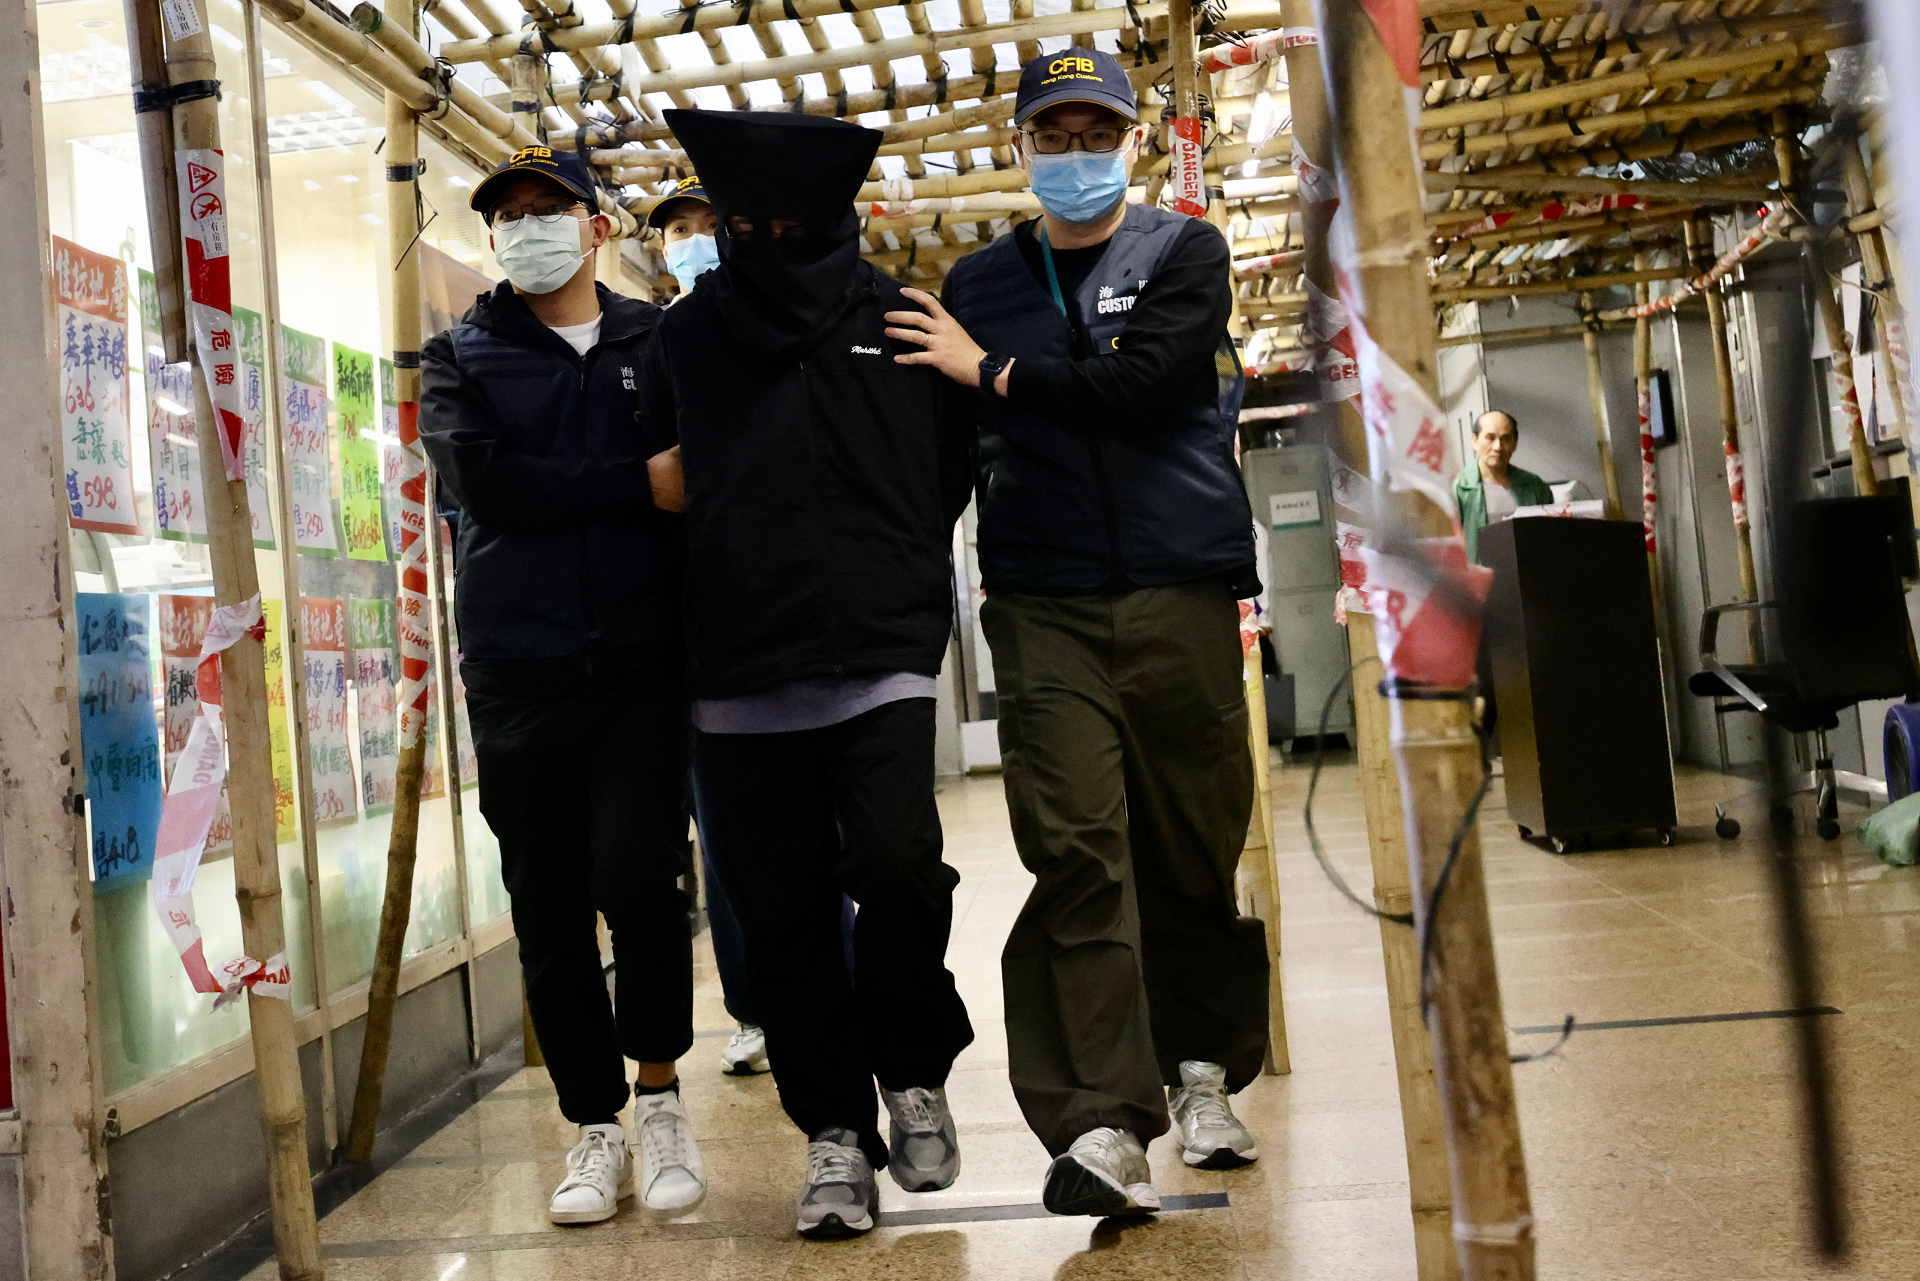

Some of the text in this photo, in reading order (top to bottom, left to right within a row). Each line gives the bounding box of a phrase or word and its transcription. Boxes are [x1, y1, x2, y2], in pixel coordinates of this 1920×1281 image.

[1048, 56, 1095, 75] CFIB
[1041, 72, 1104, 86] Hong Kong Customs
[509, 146, 553, 164] CFIB
[1181, 142, 1199, 200] DANGER
[1098, 285, 1115, 300] 海
[1097, 295, 1138, 315] CUSTO
[210, 328, 236, 386] 危險
[84, 475, 117, 510] 598
[304, 510, 324, 538] 250
